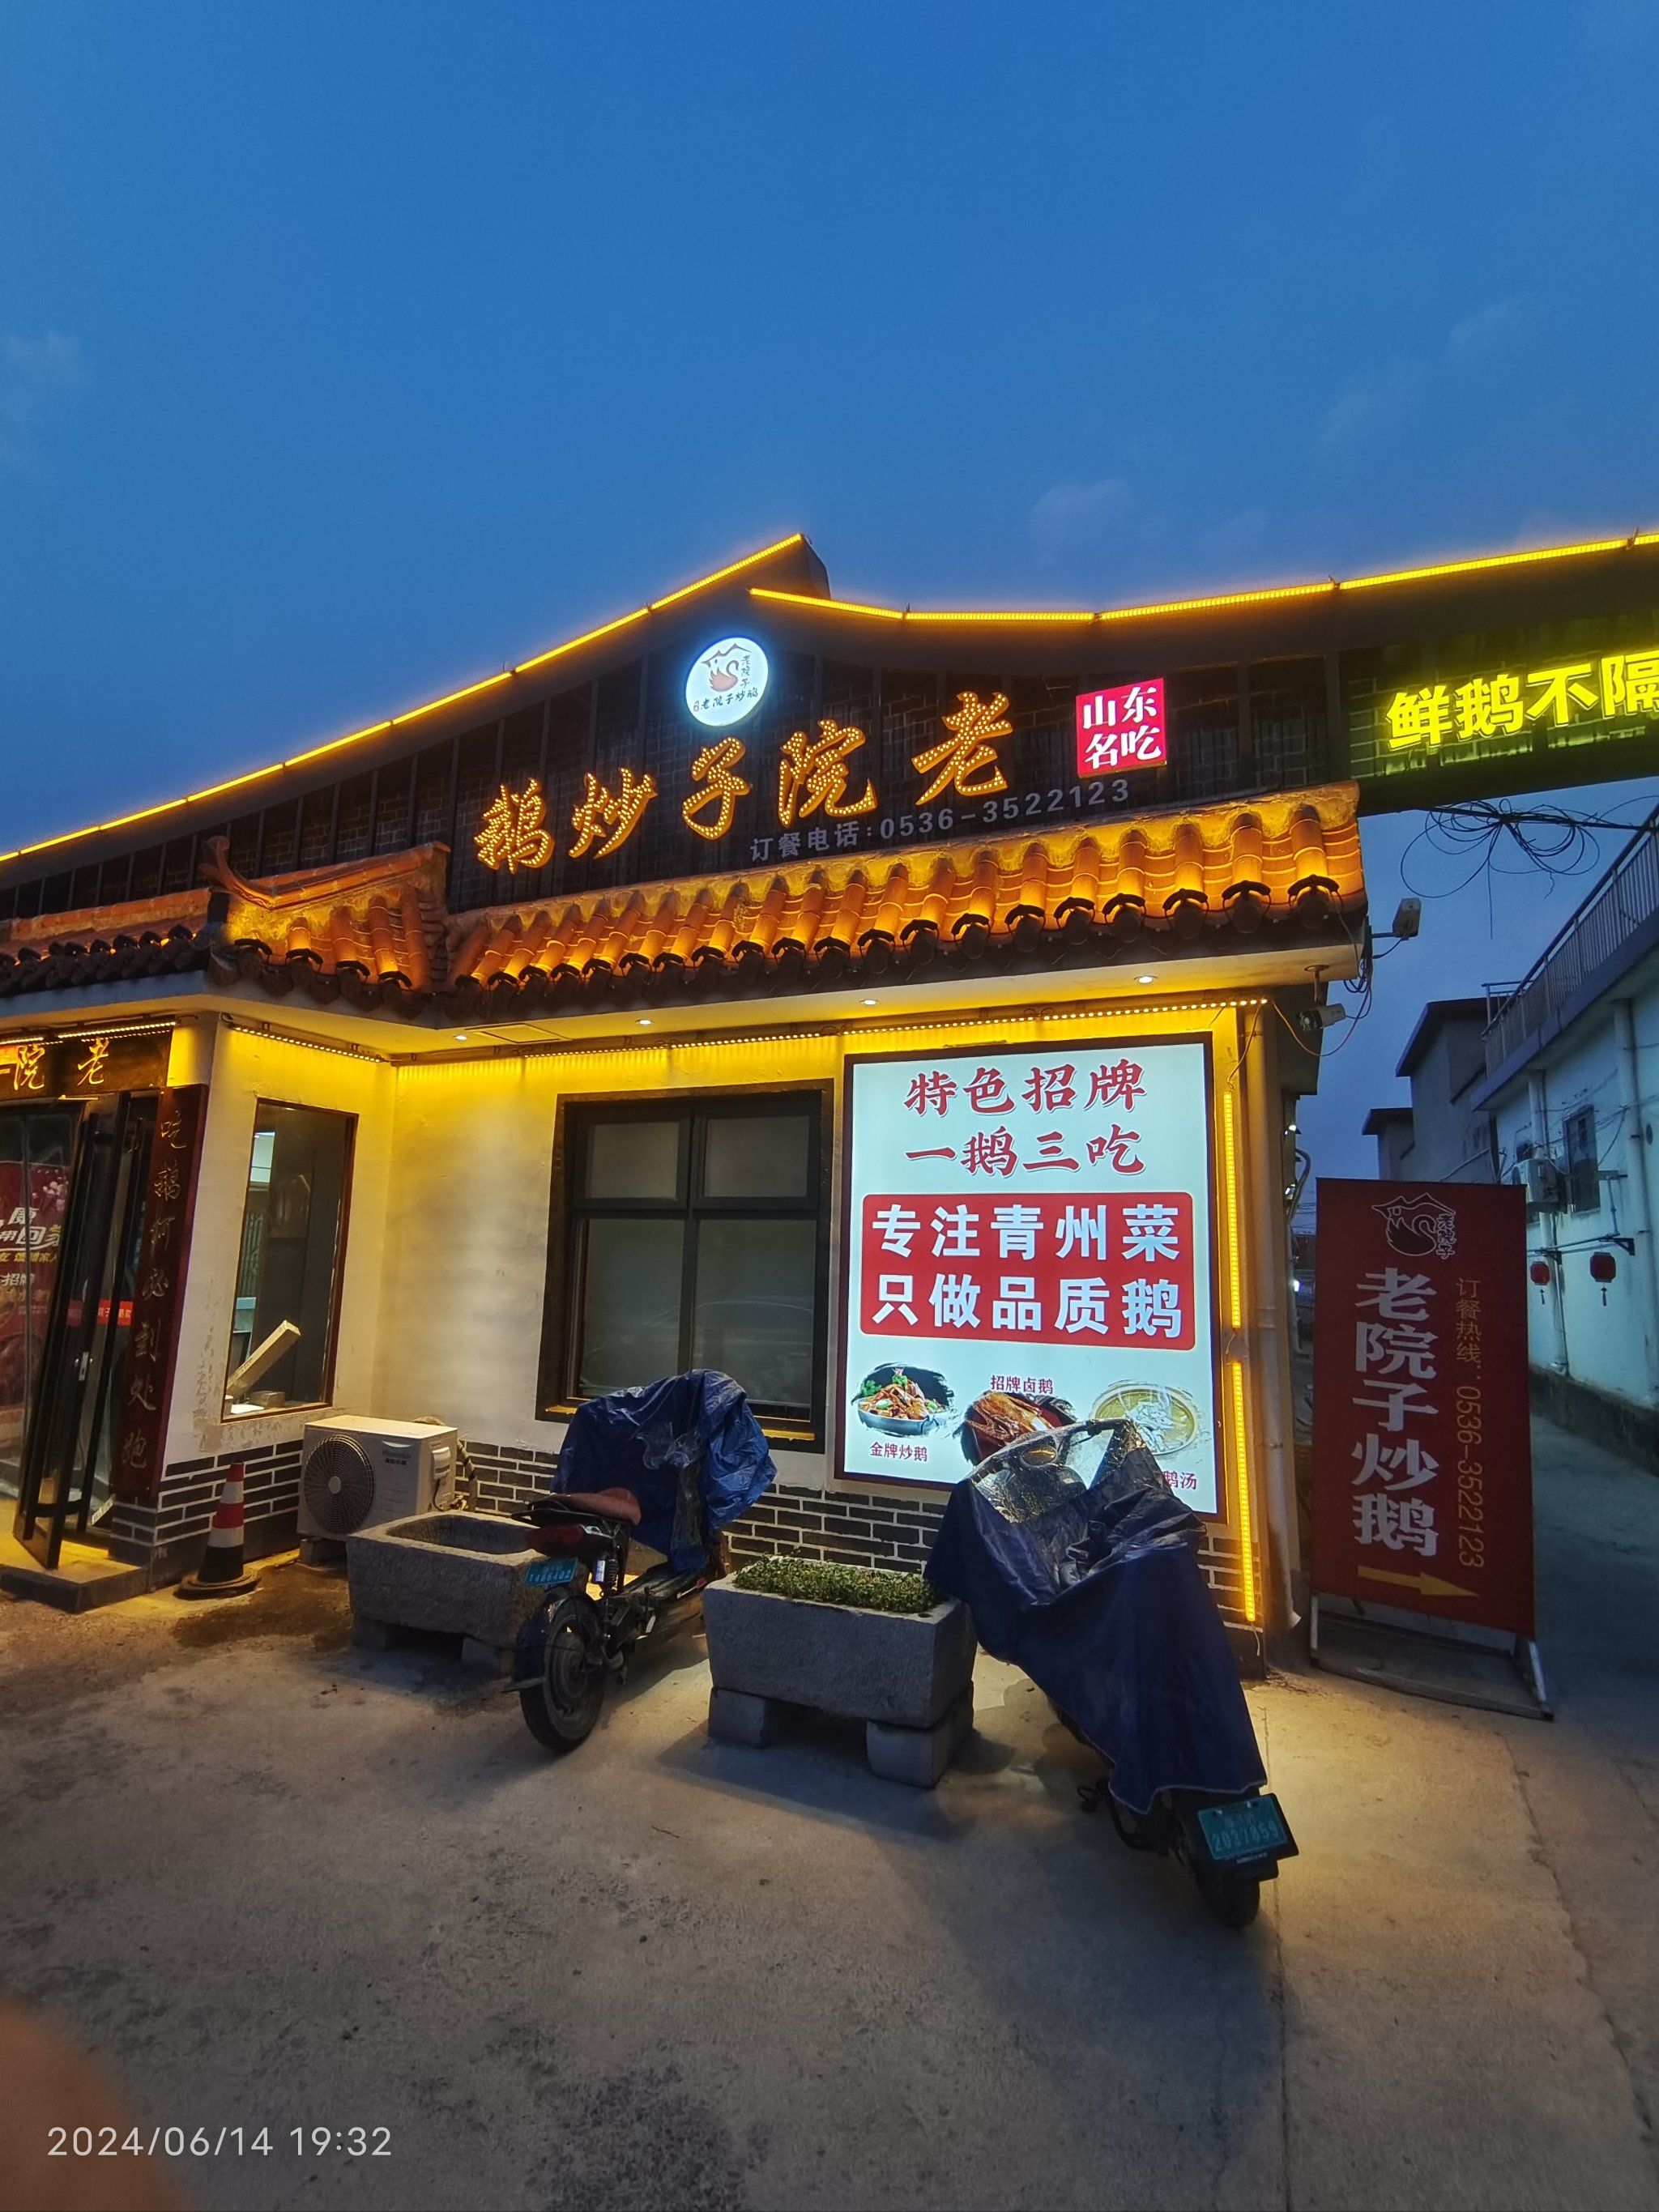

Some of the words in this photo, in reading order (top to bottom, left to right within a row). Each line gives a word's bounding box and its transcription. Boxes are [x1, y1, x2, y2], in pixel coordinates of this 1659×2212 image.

[1082, 686, 1158, 729] 山东
[1085, 725, 1163, 770] 名吃
[903, 1059, 1146, 1116] 特色招牌
[905, 1124, 1145, 1177] 一鹅三吃
[872, 1204, 1179, 1262] 专注青州菜
[872, 1274, 1183, 1338] 只做品质鹅
[990, 1375, 1054, 1395] 招牌卤鹅
[1352, 1268, 1439, 1558] 老院子炒鹅
[869, 1441, 928, 1462] 金牌炒鹅
